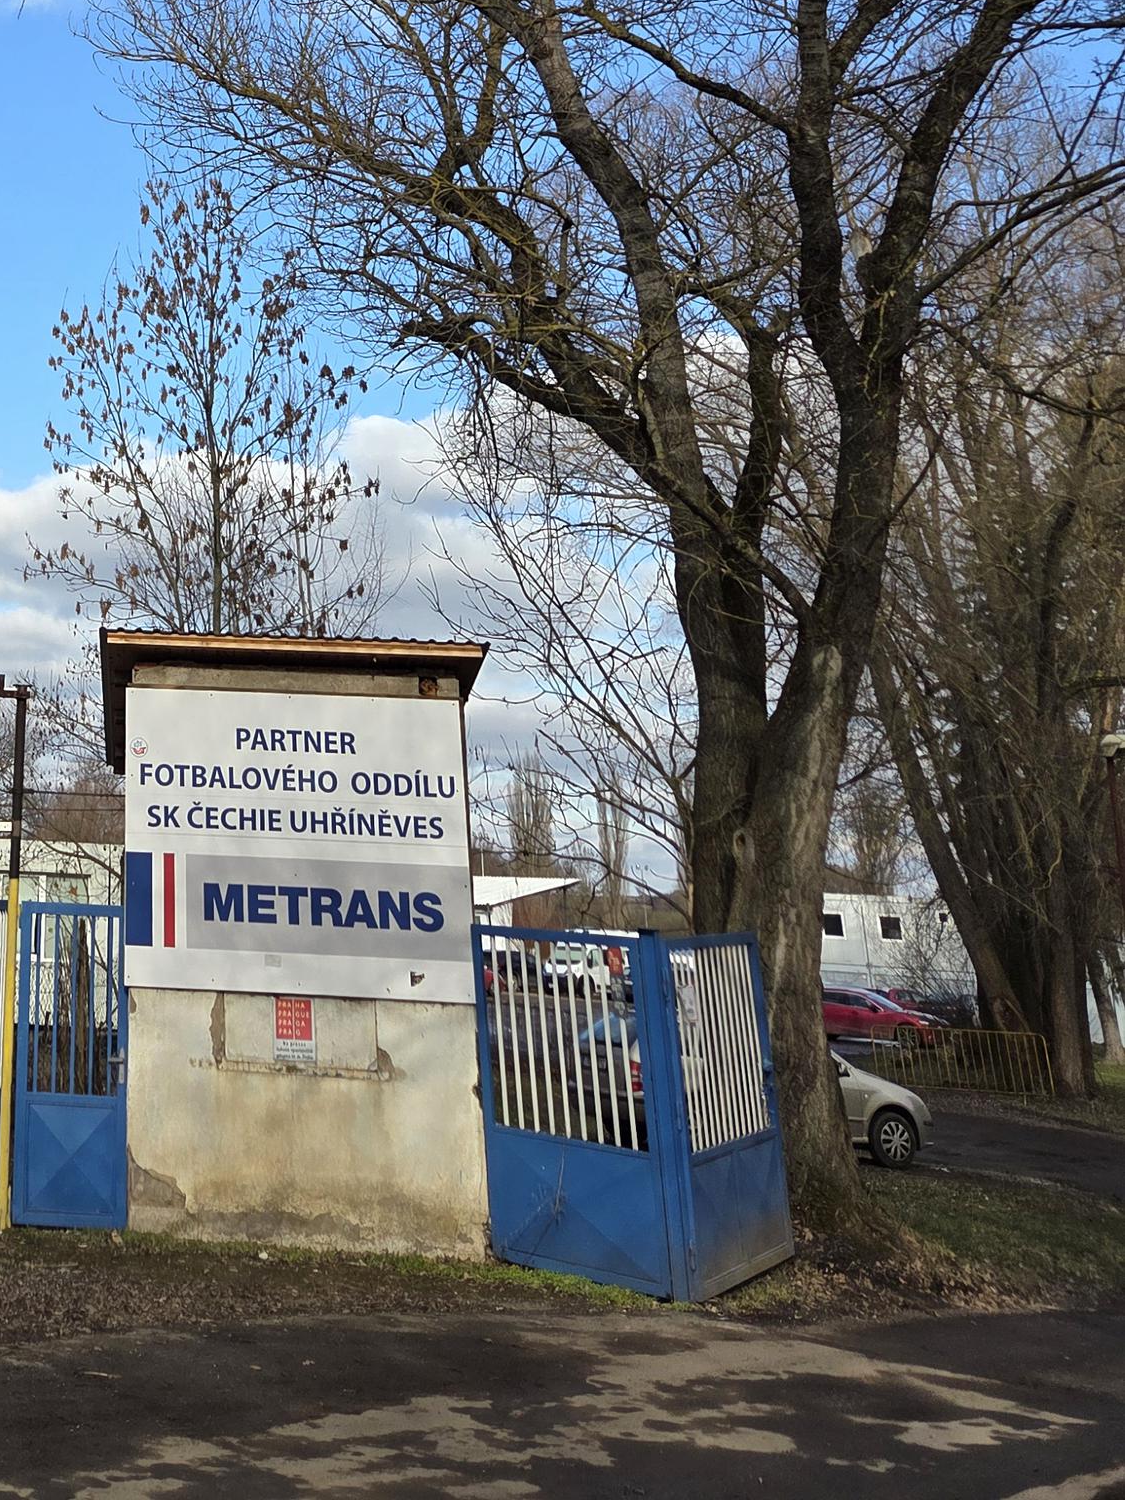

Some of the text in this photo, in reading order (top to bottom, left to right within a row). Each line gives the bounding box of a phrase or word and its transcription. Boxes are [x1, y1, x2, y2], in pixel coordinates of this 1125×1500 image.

[236, 727, 356, 755] PARTNER
[139, 763, 455, 798] FOTBALOVÉHO ODDÍLU
[147, 801, 444, 839] SK ČECHIE UHŘÍNĚVES
[203, 882, 444, 933] METRANS
